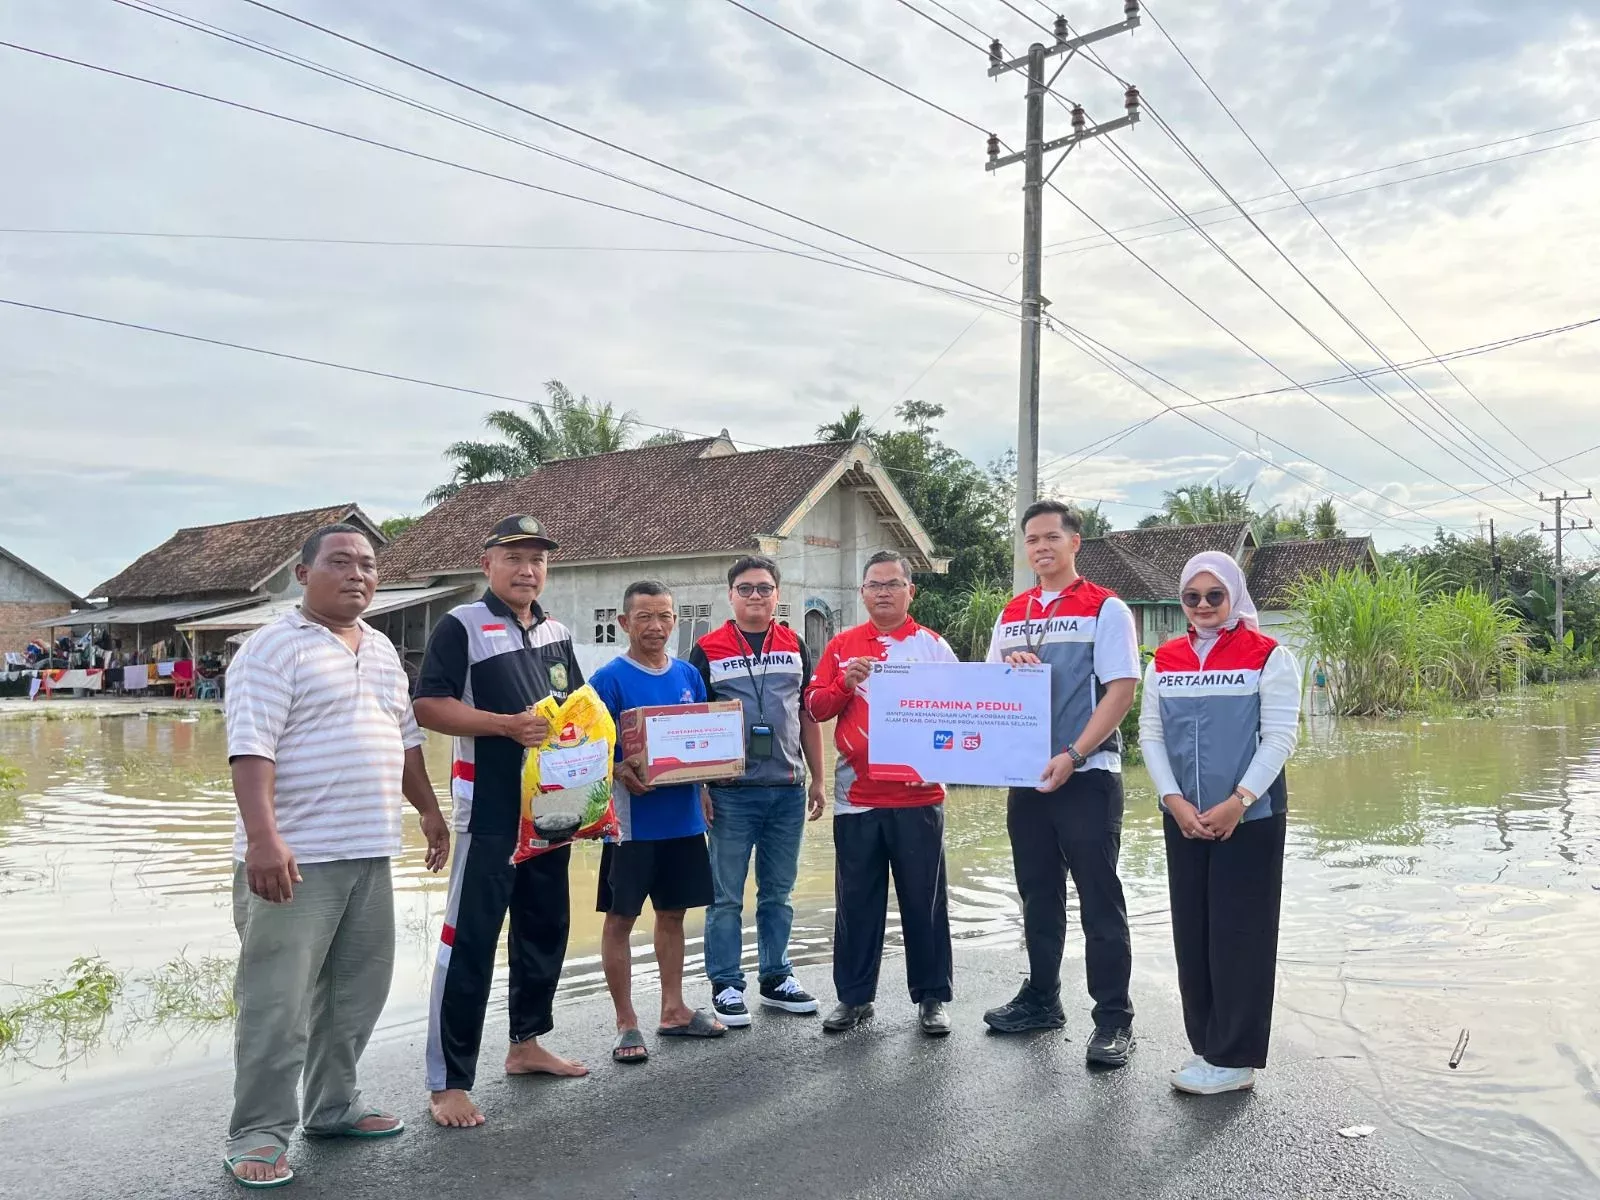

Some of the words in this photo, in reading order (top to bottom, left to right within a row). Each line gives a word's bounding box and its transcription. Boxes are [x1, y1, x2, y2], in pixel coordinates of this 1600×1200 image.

[1005, 621, 1078, 637] PERTAMINA
[722, 655, 793, 671] PERTAMINA
[1158, 673, 1245, 687] PERTAMINA
[900, 700, 972, 710] PERTAMINA
[976, 701, 1022, 711] PEDULI
